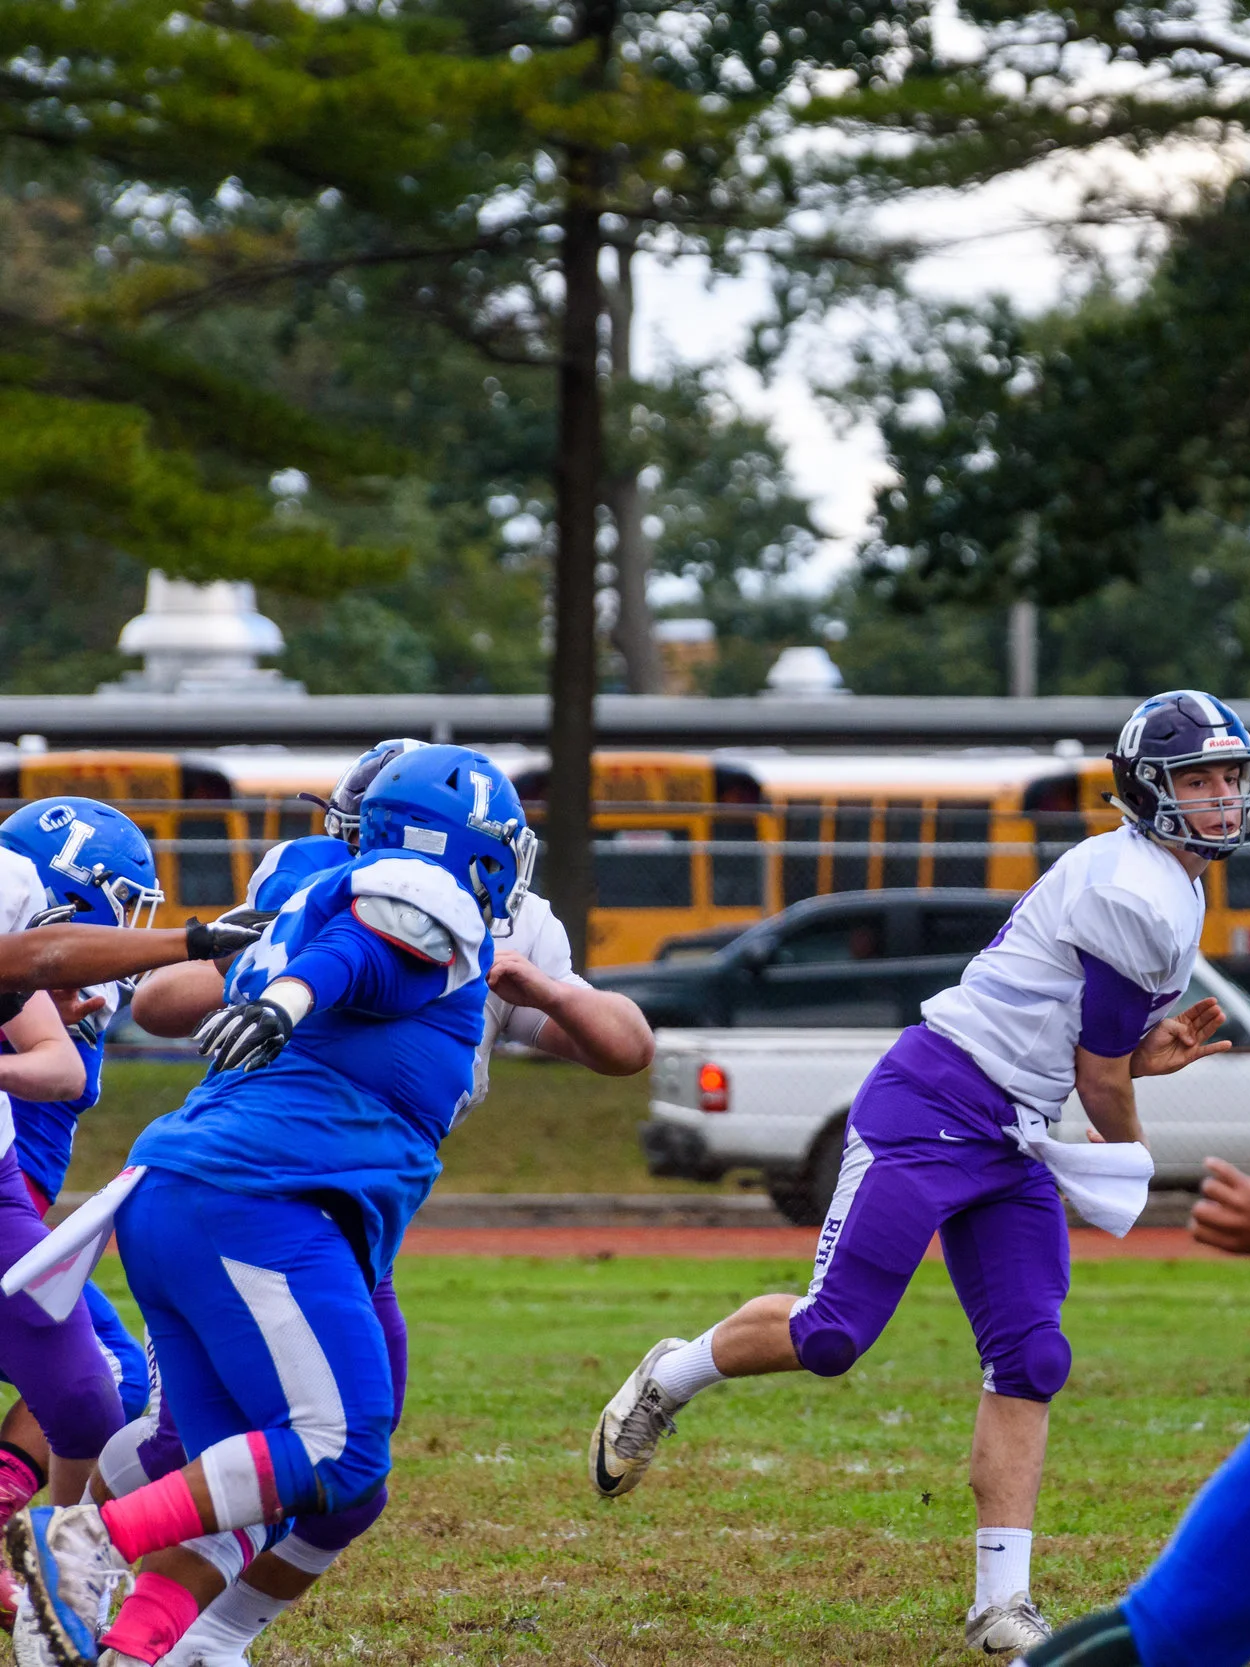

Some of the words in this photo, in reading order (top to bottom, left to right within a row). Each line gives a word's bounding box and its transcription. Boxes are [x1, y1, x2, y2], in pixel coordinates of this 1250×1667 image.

[1208, 738, 1241, 748] Riddell
[465, 770, 506, 842] L
[49, 818, 96, 886] L
[815, 1217, 843, 1267] RFH
